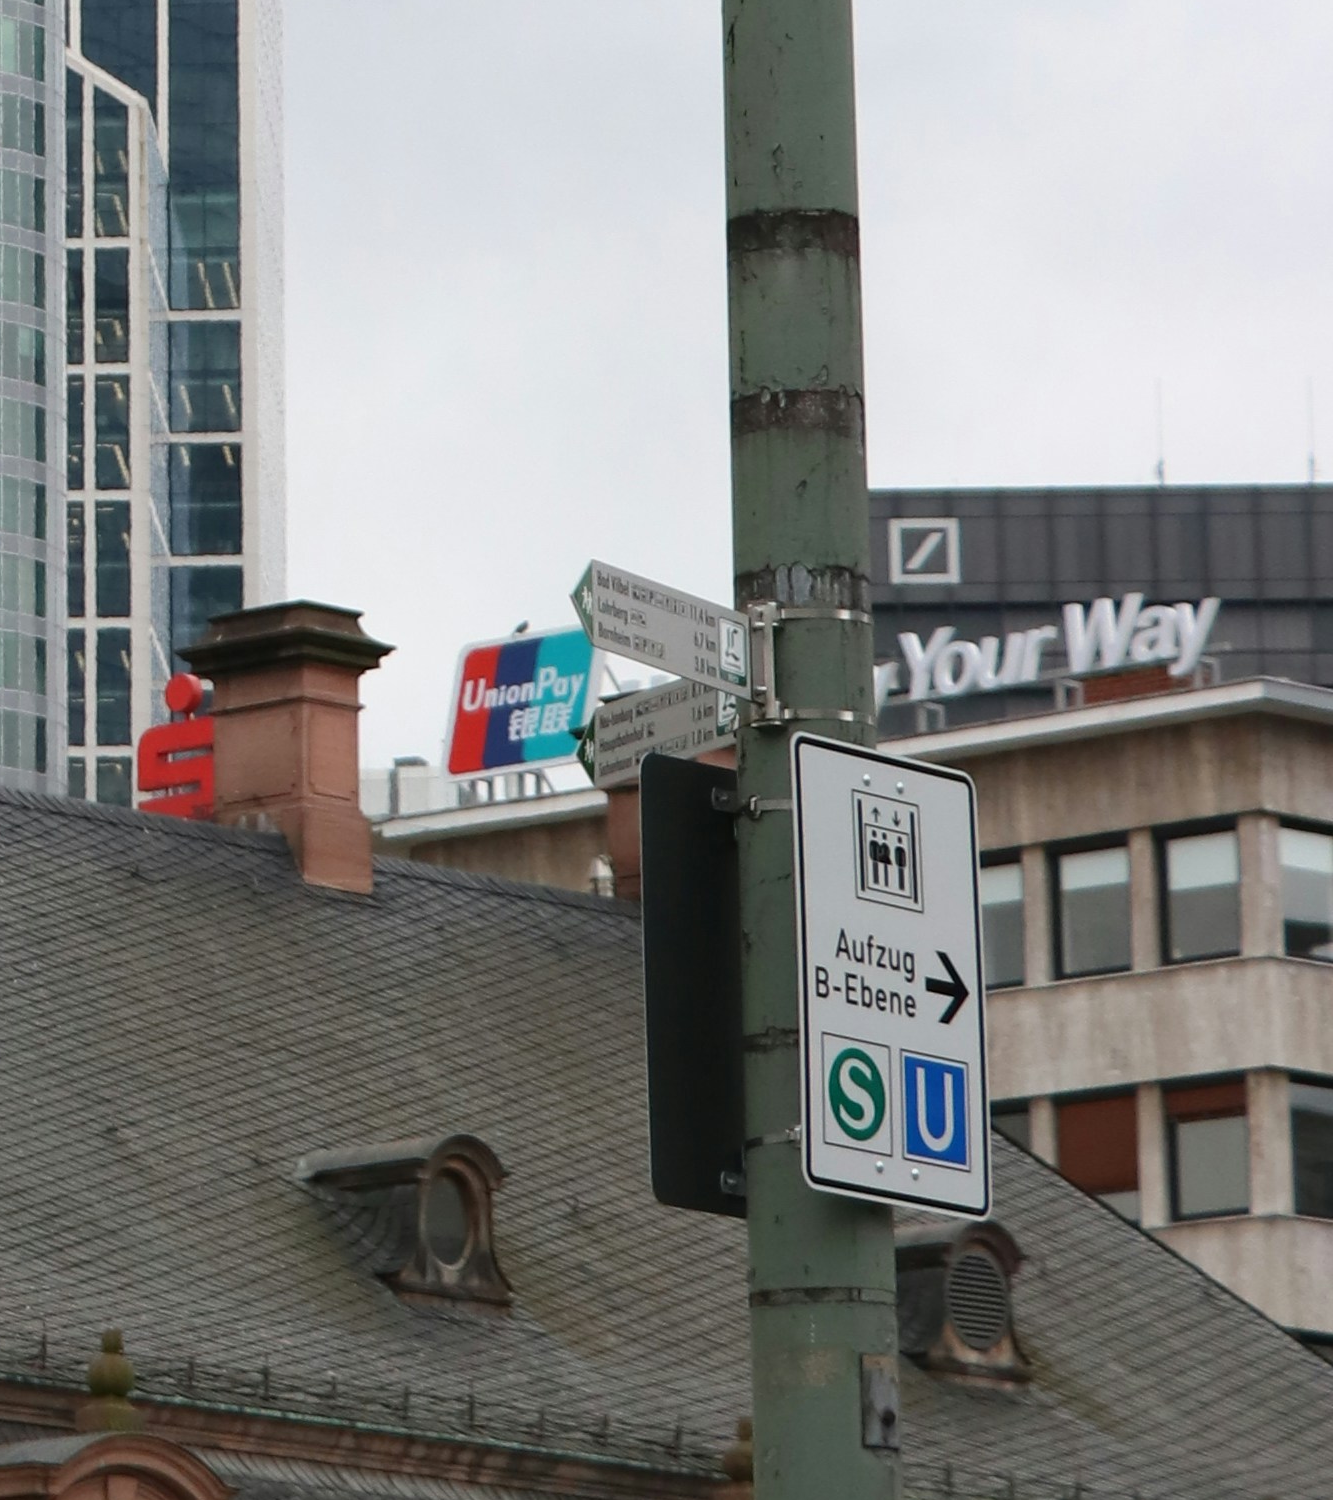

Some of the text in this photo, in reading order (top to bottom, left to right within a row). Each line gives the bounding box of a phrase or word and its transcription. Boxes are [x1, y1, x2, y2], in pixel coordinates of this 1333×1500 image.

[705, 611, 716, 628] km
[705, 634, 716, 652] km
[898, 625, 1057, 701] Your
[1063, 592, 1222, 678] Way
[706, 658, 717, 677] km
[462, 666, 586, 713] UnionPay
[507, 702, 573, 742] 银联
[703, 704, 714, 718] km
[703, 729, 714, 742] km
[835, 928, 917, 983] Aufzug
[815, 966, 918, 1018] B-Ebene
[837, 1055, 955, 1152] S U
